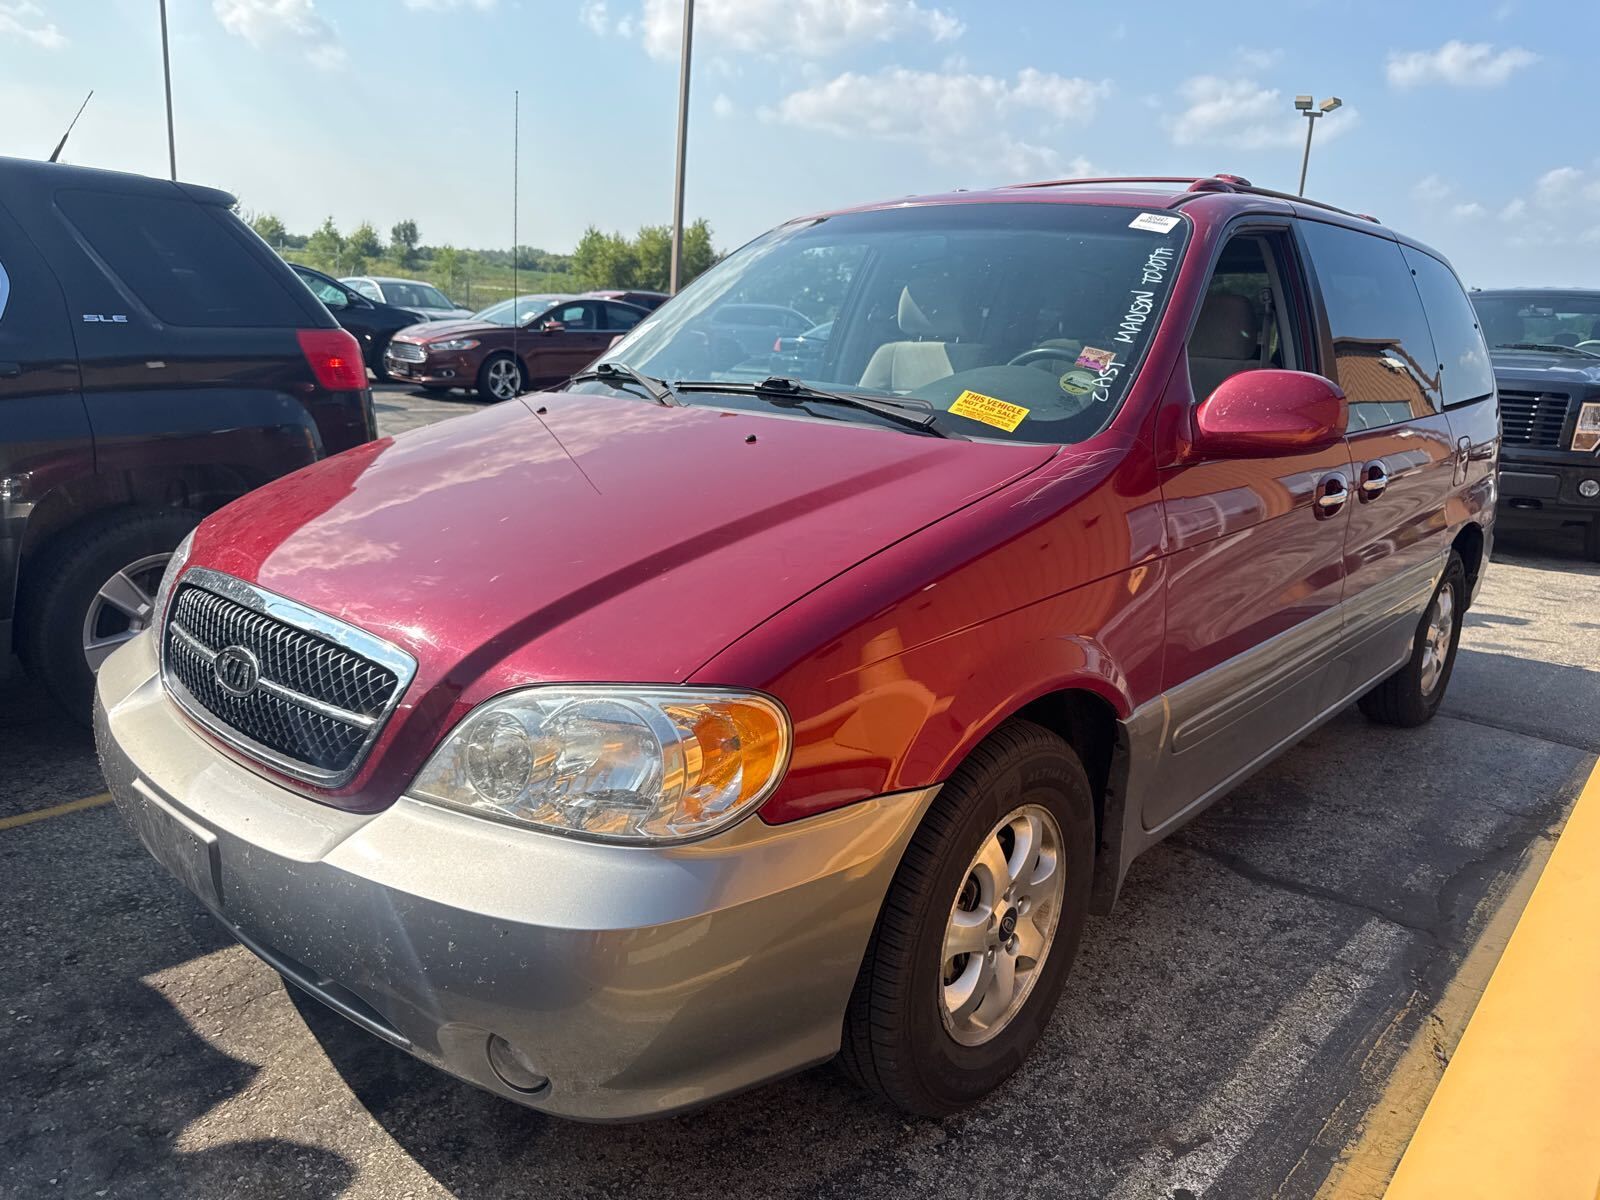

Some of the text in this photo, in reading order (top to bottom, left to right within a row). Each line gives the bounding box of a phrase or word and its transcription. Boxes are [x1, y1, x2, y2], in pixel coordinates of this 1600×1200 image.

[1113, 290, 1155, 344] MADISON
[1141, 247, 1175, 285] TOYOTA
[82, 314, 128, 323] SLE
[962, 399, 978, 407] NOT
[979, 403, 996, 412] FOR
[997, 409, 1019, 420] SALE
[966, 392, 986, 403] THIS
[986, 397, 1025, 416] VEHICLE
